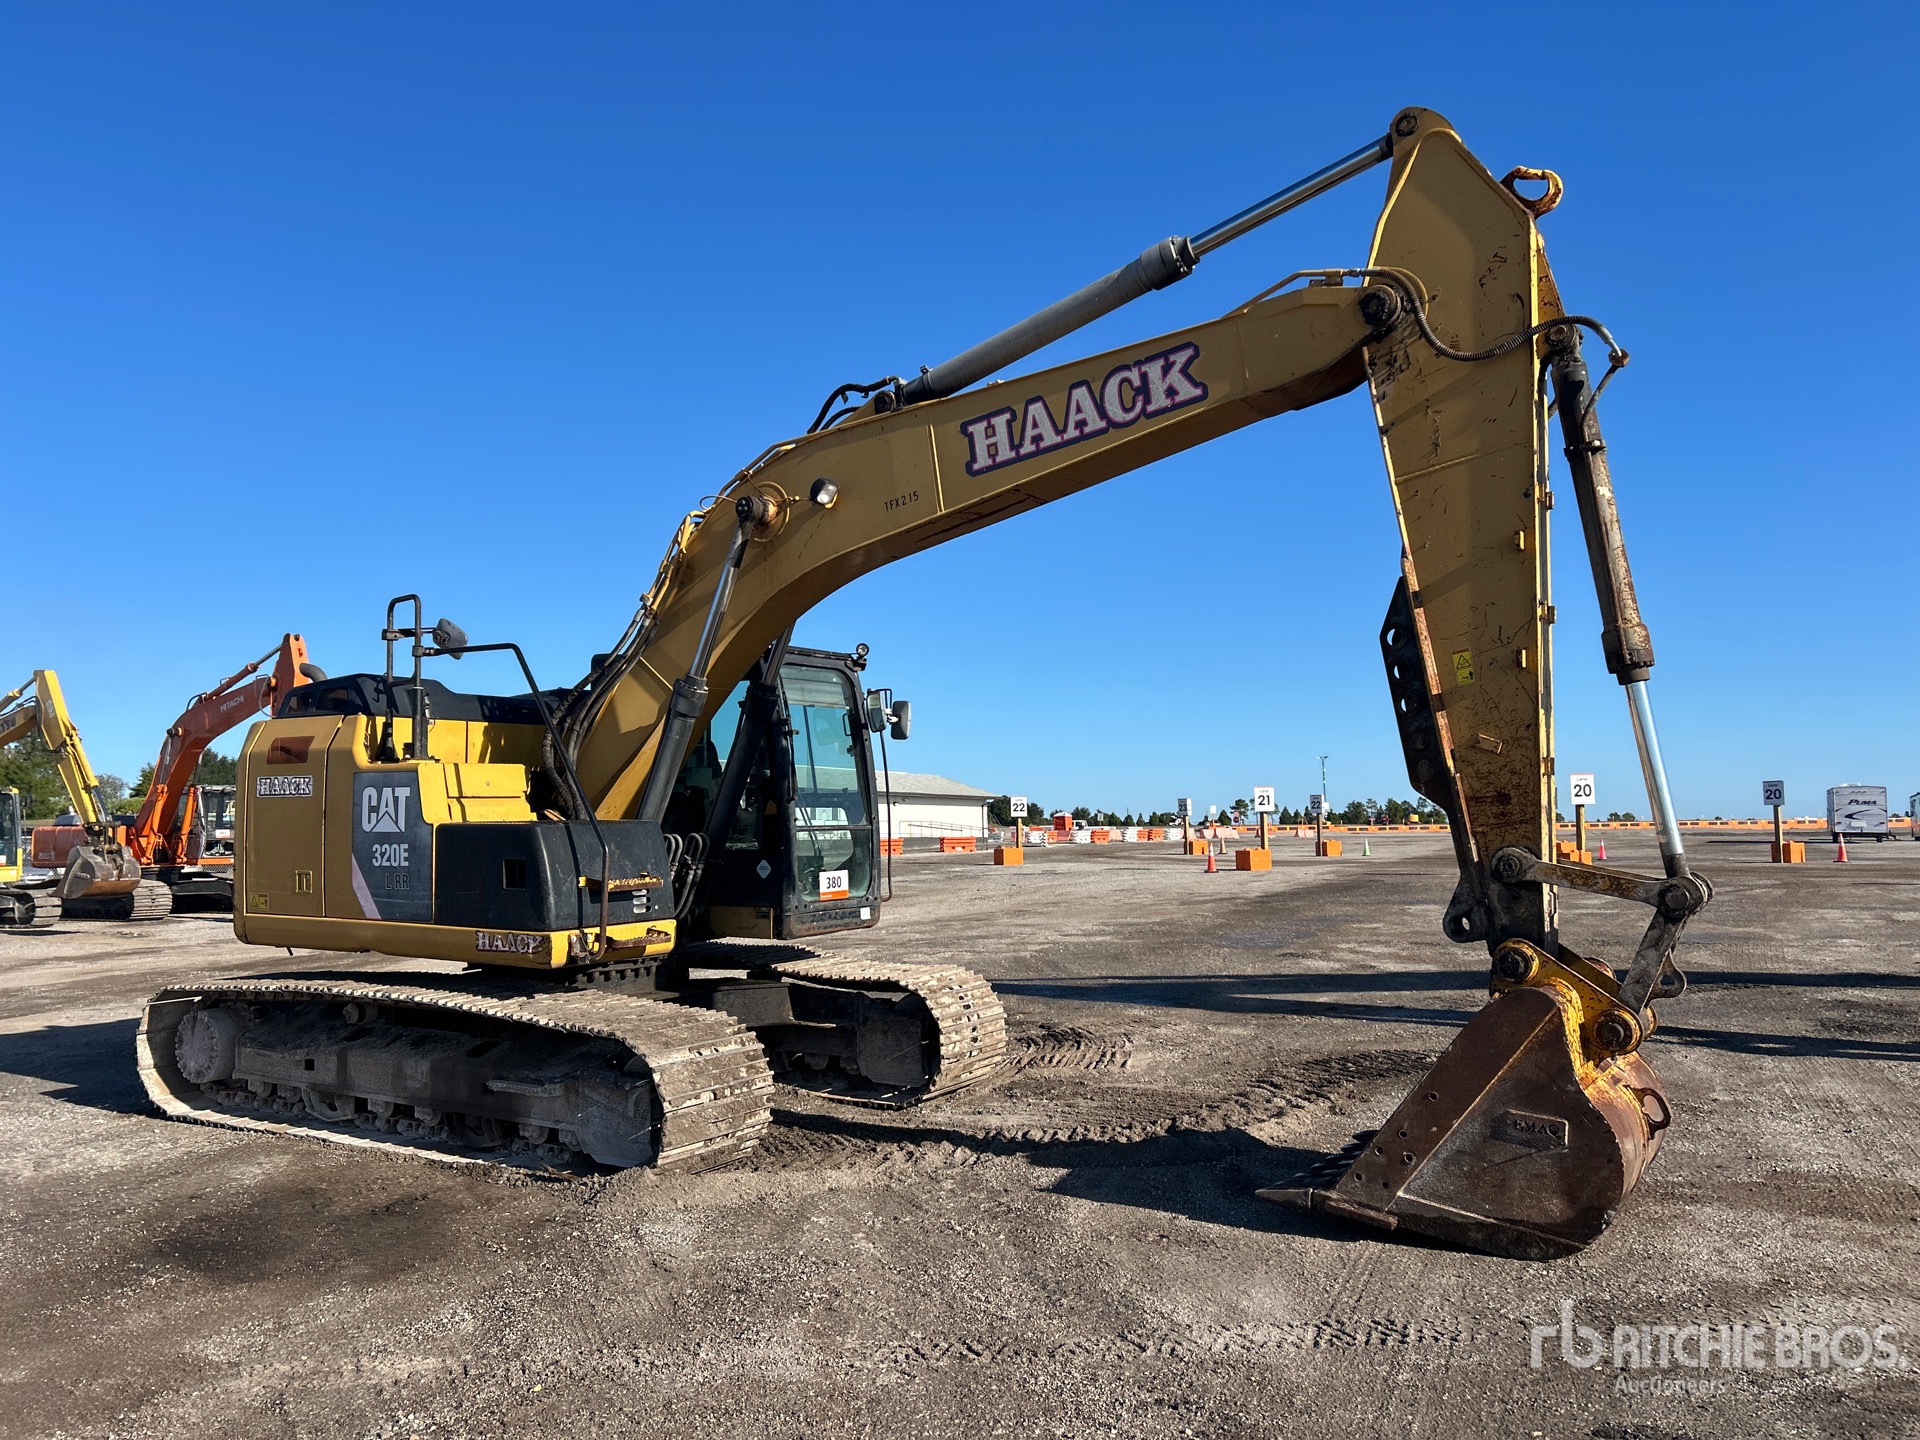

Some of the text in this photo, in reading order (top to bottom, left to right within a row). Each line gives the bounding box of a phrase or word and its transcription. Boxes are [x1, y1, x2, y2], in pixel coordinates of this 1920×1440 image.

[963, 344, 1206, 474] HAACK
[220, 695, 245, 712] HITACHI
[259, 777, 311, 796] HAACK
[1573, 784, 1592, 797] 20
[1258, 795, 1270, 806] 21
[1765, 788, 1782, 800] 20
[362, 787, 410, 832] CAT
[1012, 803, 1025, 812] 22
[1178, 803, 1188, 812] 23
[1311, 801, 1321, 810] 22
[372, 843, 409, 867] 320E
[826, 876, 842, 889] 380
